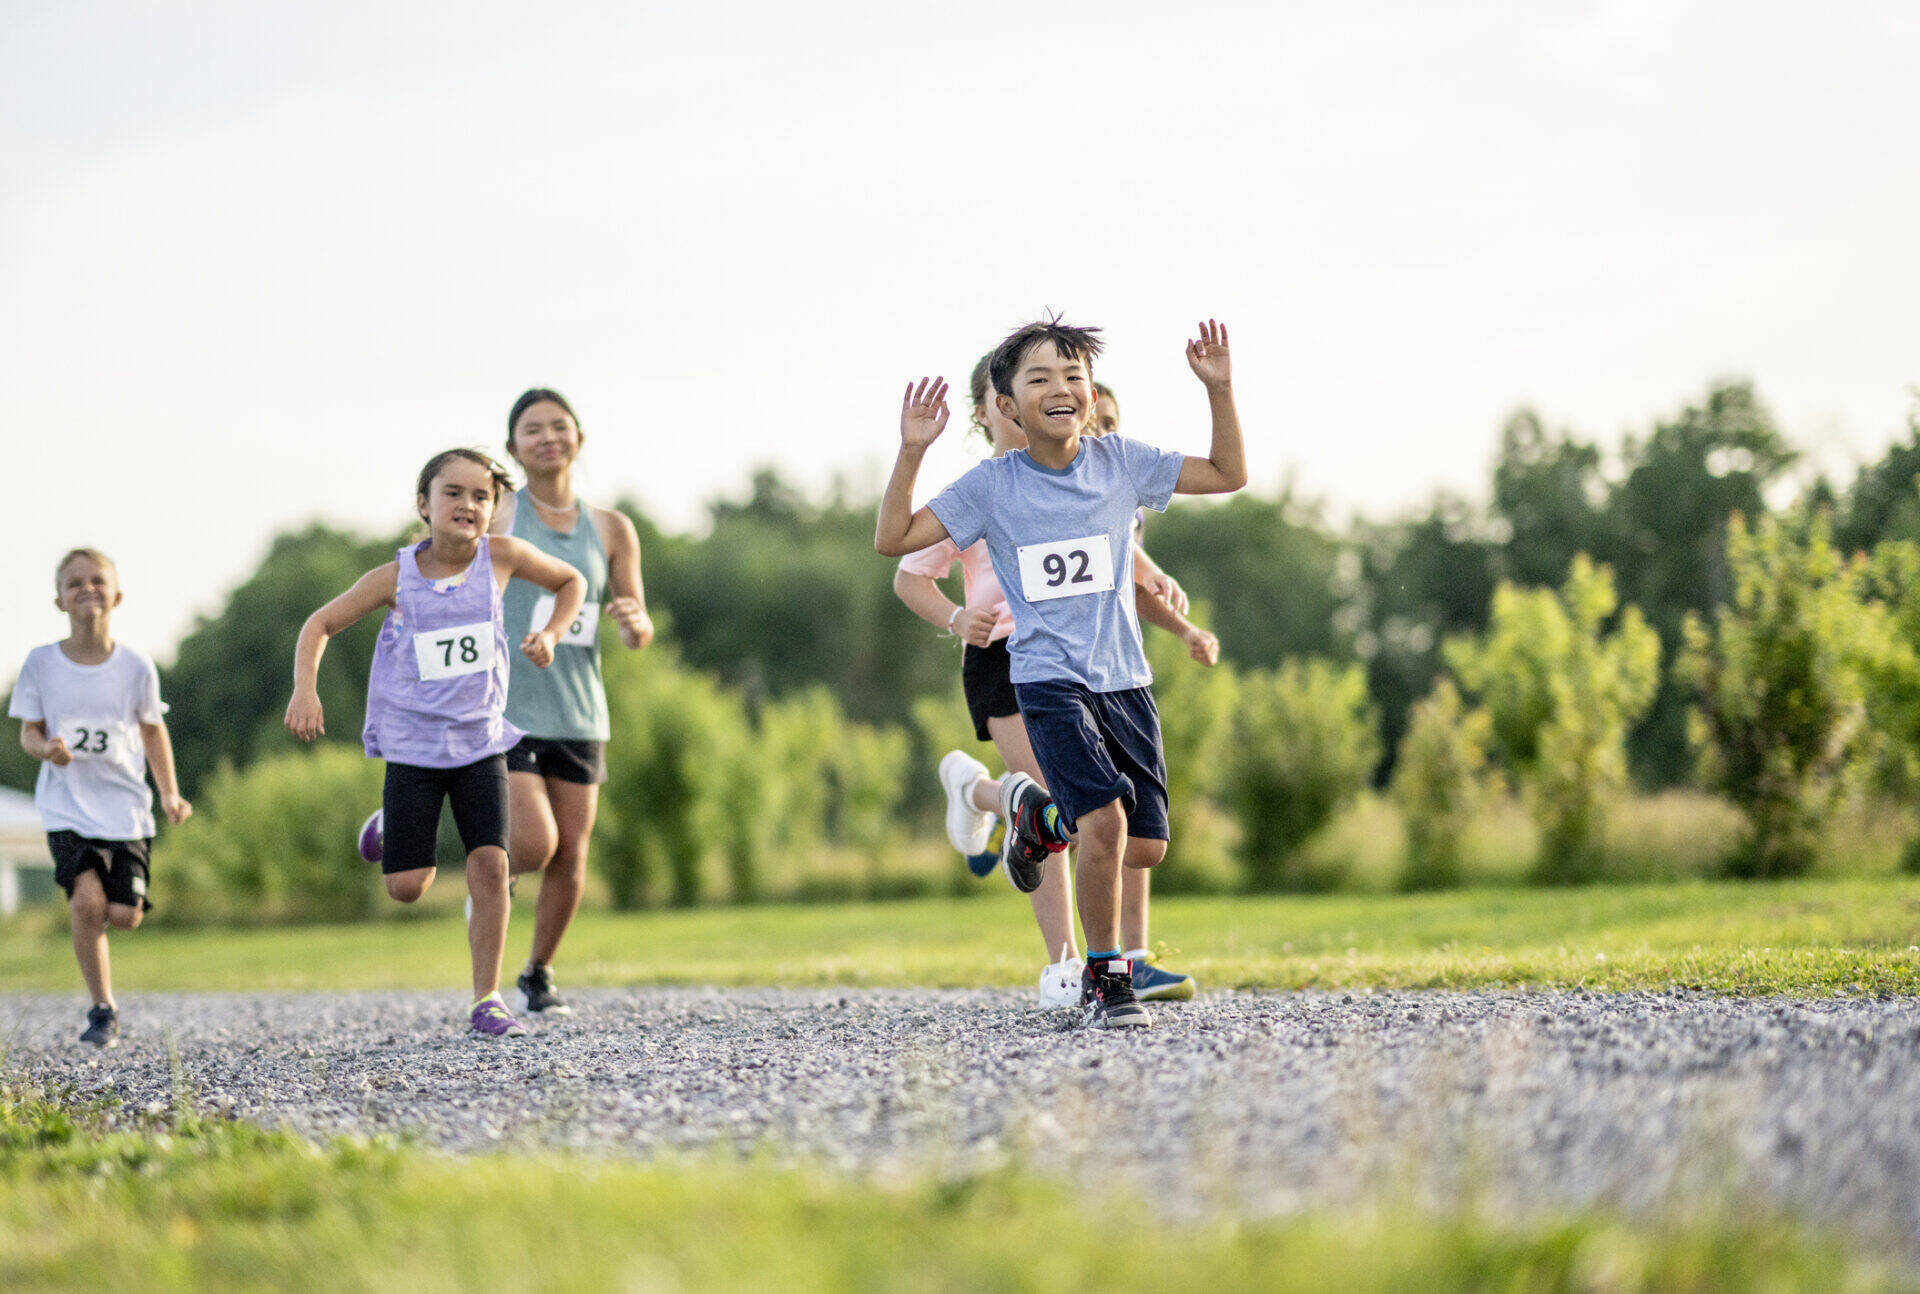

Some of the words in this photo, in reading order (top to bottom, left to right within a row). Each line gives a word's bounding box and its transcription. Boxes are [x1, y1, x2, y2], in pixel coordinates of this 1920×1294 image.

[1043, 550, 1093, 587] 92
[569, 611, 584, 635] 6
[436, 636, 479, 667] 78
[73, 727, 109, 753] 23
